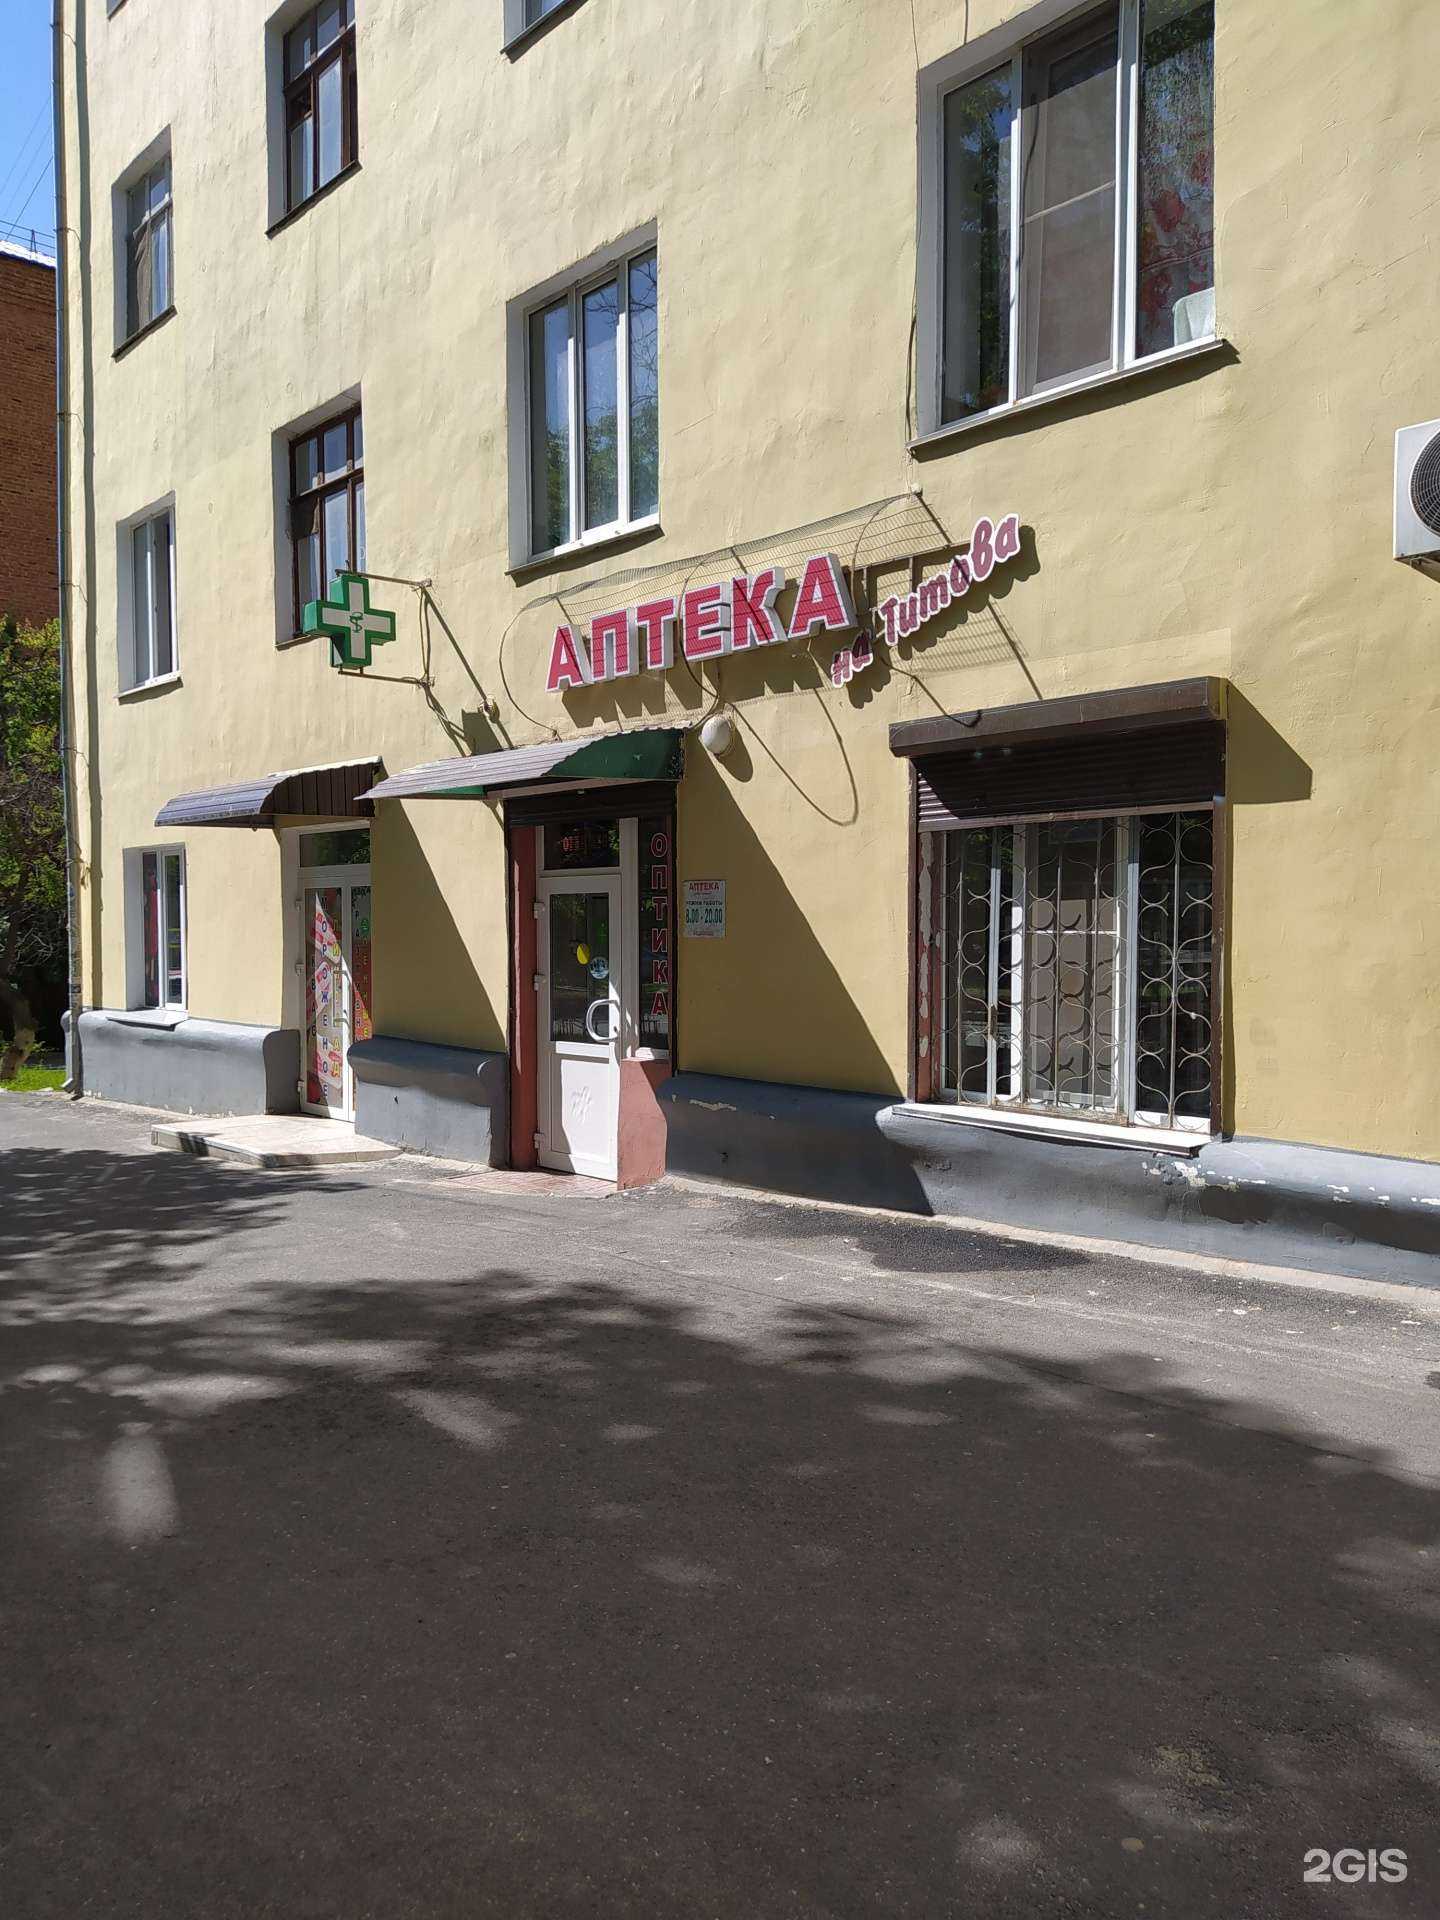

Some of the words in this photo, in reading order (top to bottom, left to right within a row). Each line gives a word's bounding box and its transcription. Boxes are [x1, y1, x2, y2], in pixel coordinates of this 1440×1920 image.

[546, 552, 857, 692] АПТЕКА
[830, 629, 875, 688] на
[877, 513, 1022, 647] Титова
[651, 832, 668, 1016] ОПТИКА
[688, 881, 720, 892] АПТЕКА
[705, 908, 723, 923] 20.00
[321, 897, 329, 1097] МОРОЖЕНОЕ
